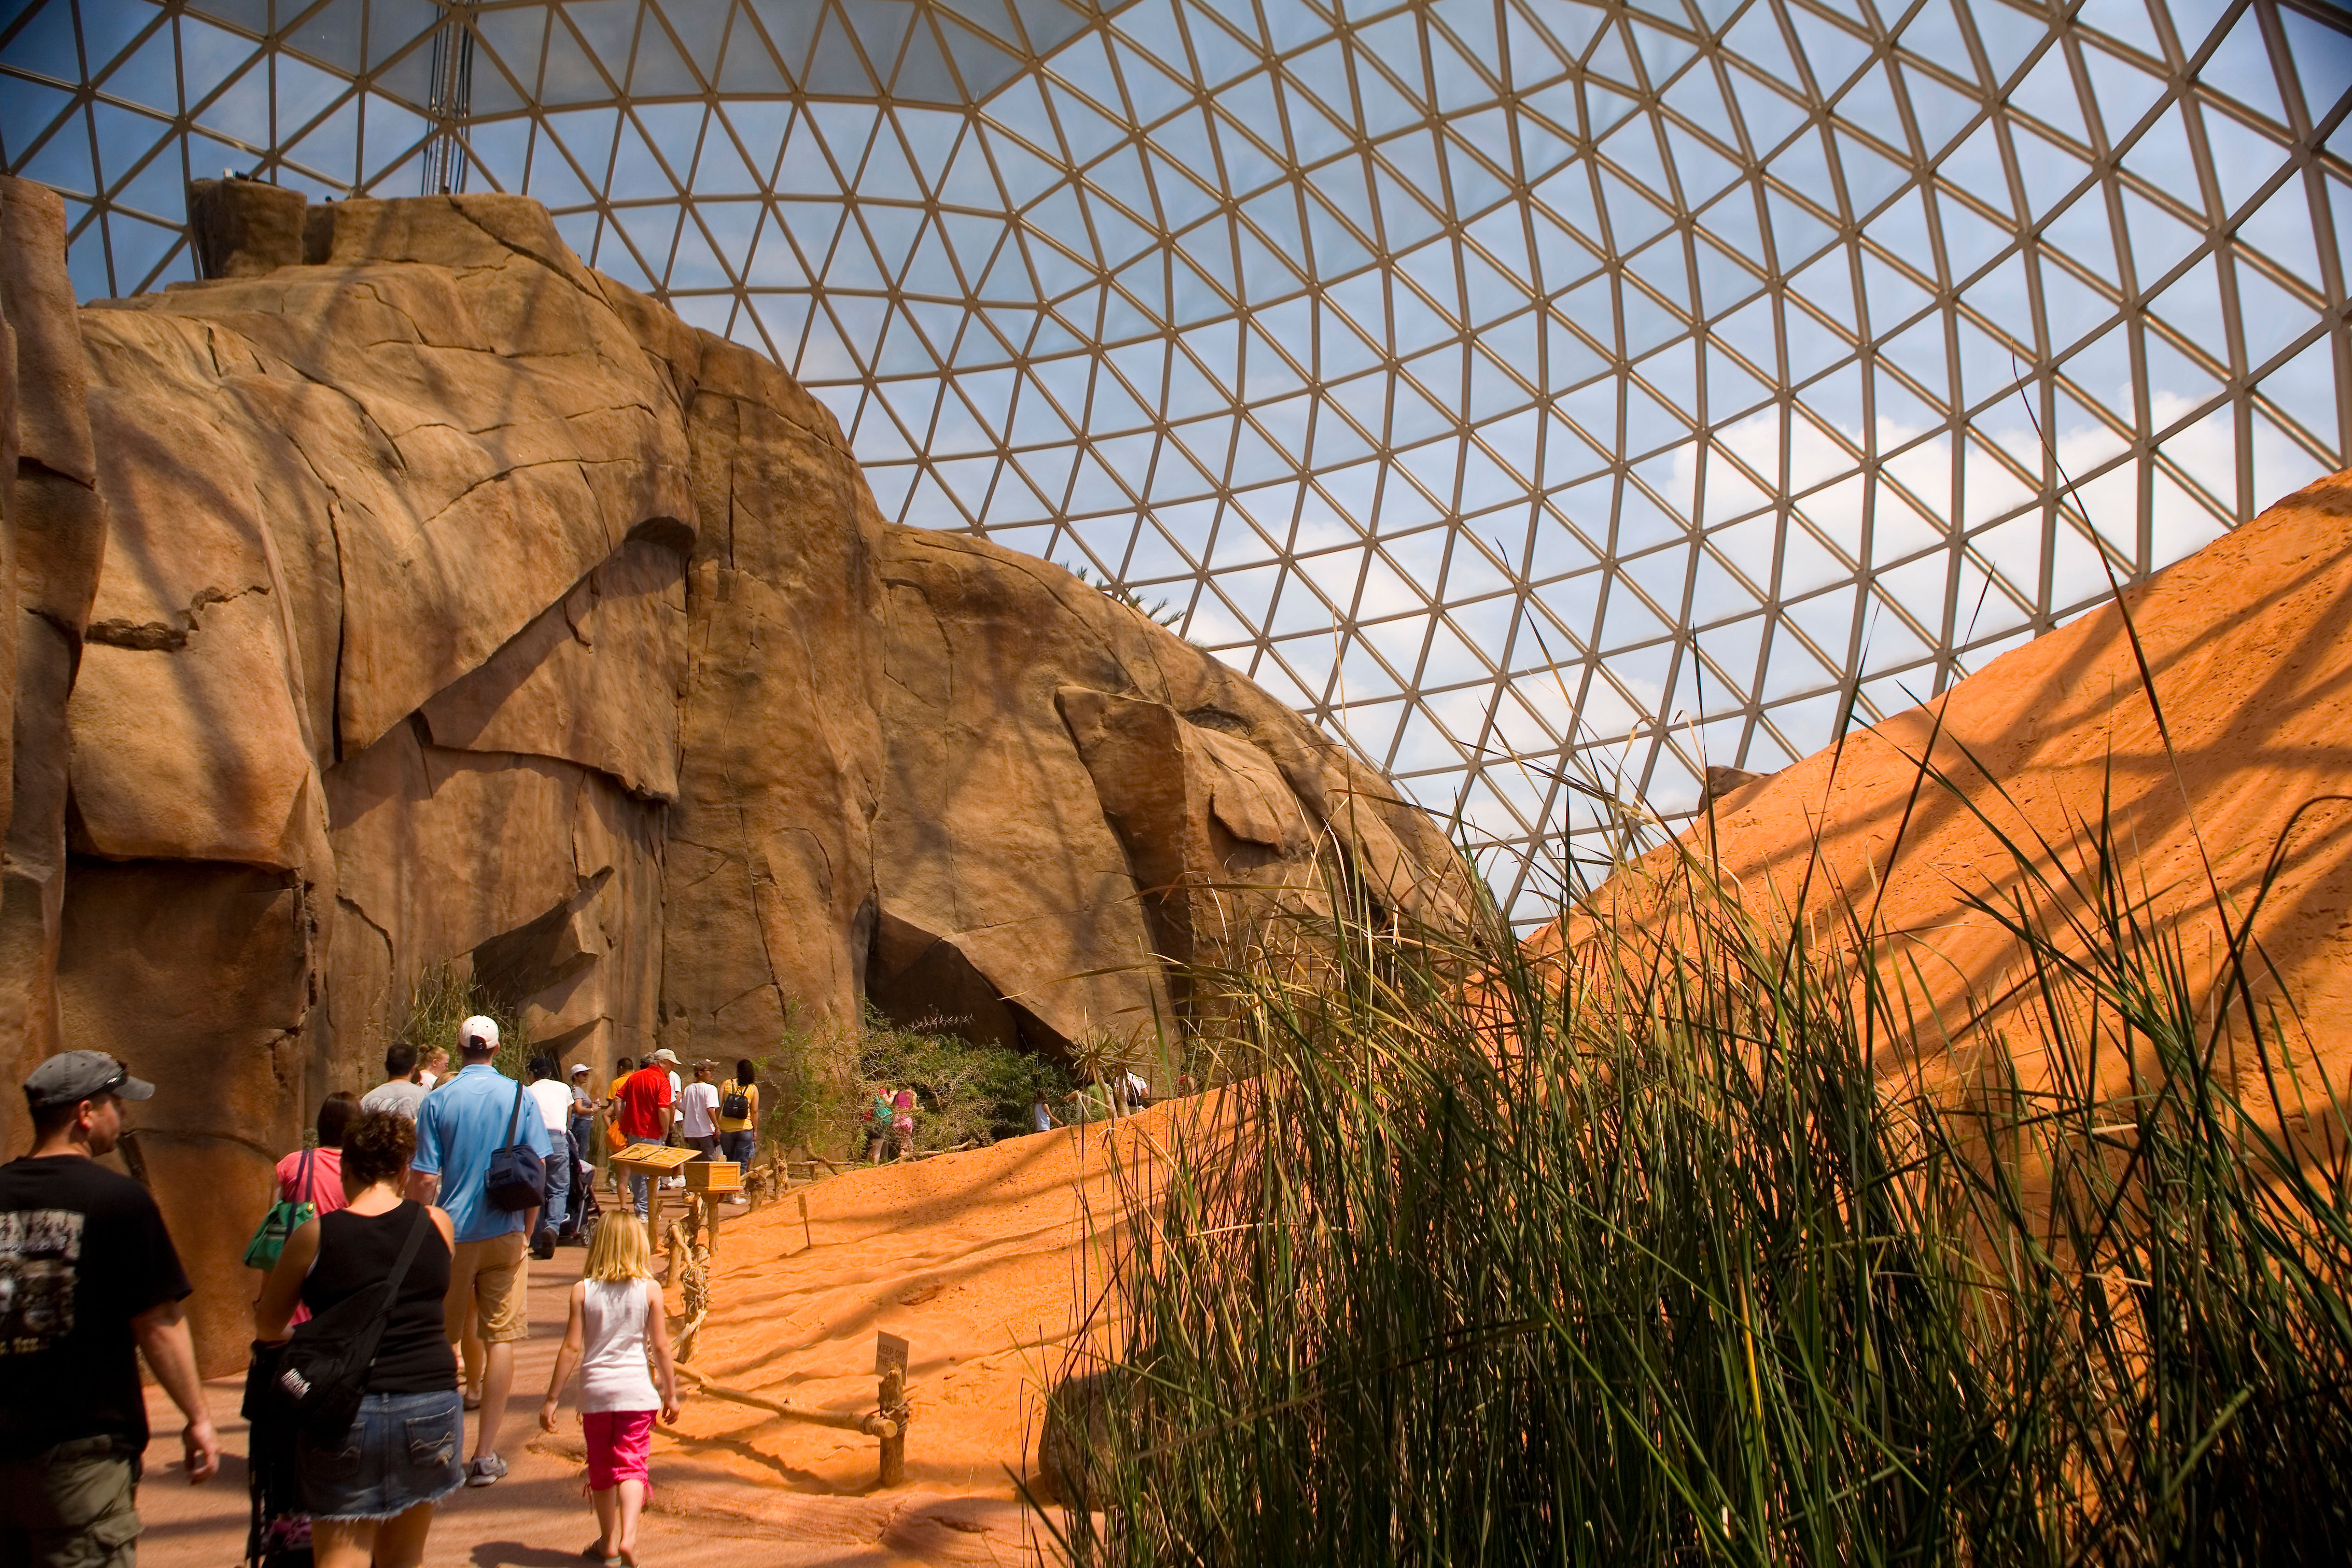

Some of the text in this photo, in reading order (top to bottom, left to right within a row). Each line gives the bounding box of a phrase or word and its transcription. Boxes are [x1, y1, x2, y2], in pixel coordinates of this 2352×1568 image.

[878, 1343, 906, 1361] KEEP OFF
[877, 1354, 888, 1367] THE
